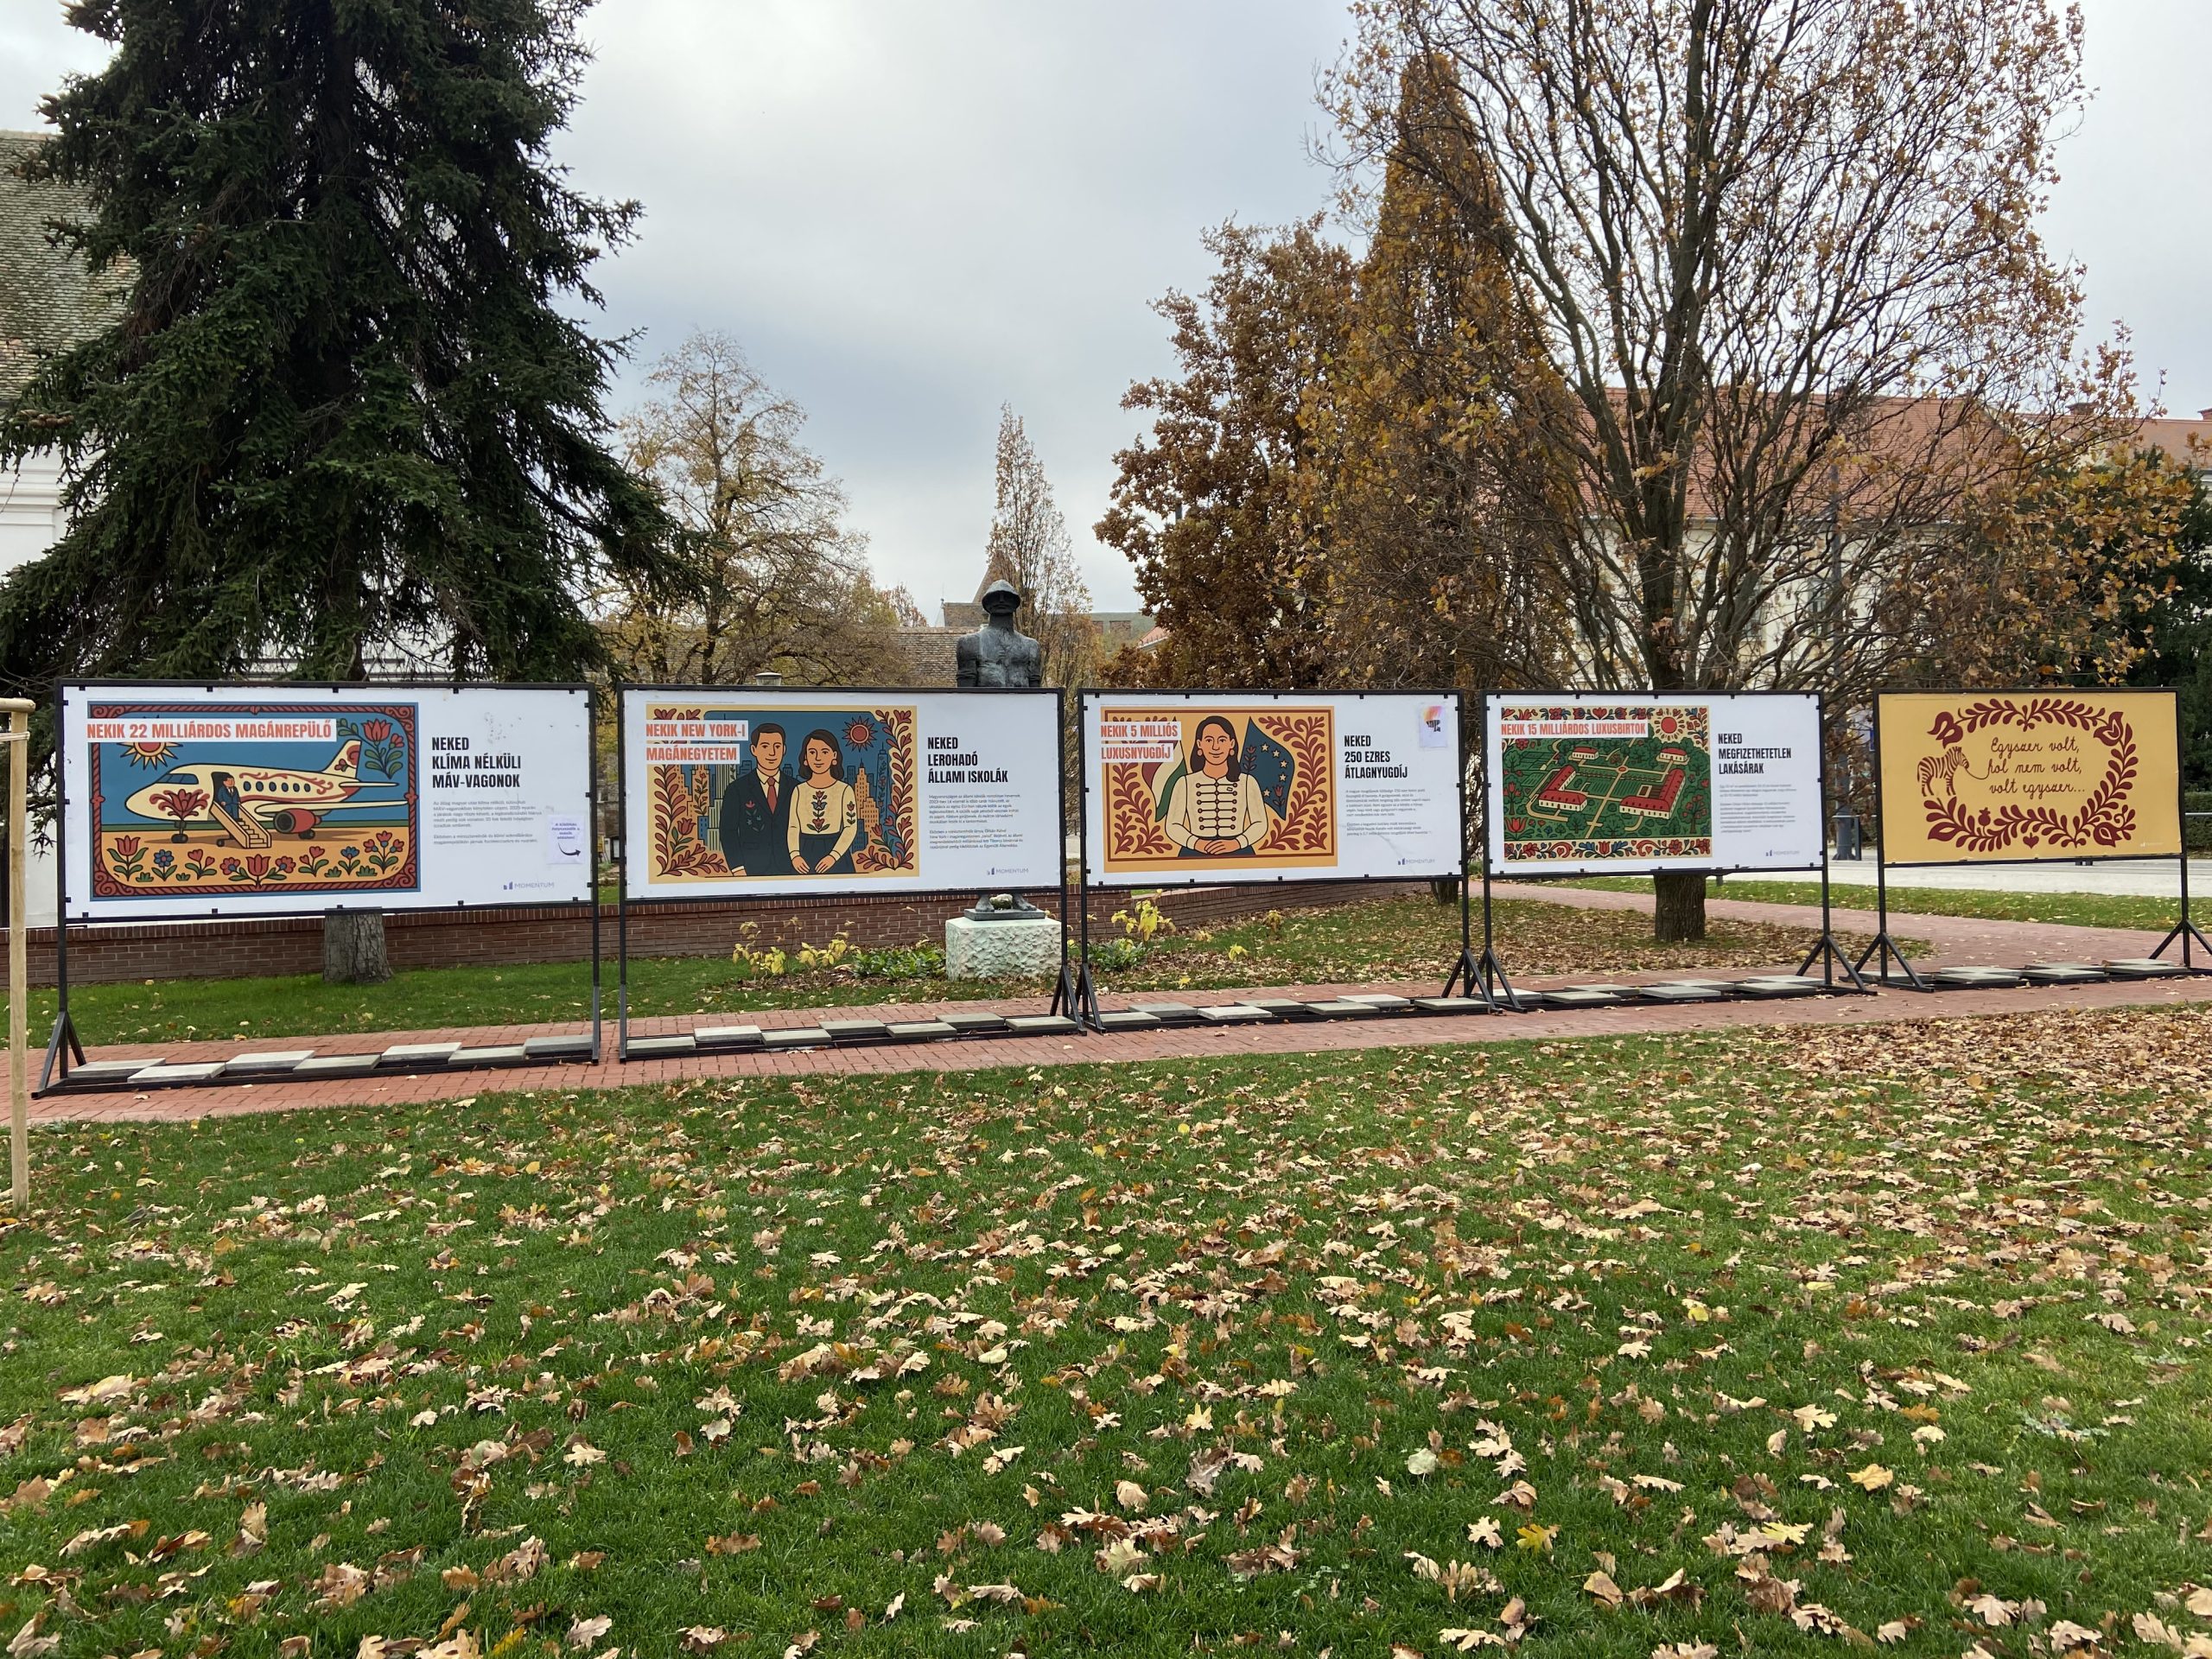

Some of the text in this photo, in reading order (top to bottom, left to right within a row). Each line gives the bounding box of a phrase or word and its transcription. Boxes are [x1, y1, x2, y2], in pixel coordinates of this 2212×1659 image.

[86, 719, 331, 739] NEKIK 22 MILLIÁRDOS MAGÁNREPÜLŐ
[645, 723, 746, 737] NEKIK NEW YORK-I
[1101, 721, 1178, 738] NEKIK 5 MILLIÓS
[1501, 721, 1646, 735] NEKIK 15 MILLIÁRDOS LUXUSBIRTOK
[431, 736, 470, 751] NEKED
[927, 736, 958, 750] NEKED
[1344, 734, 1372, 747] NEKED
[1718, 733, 1743, 745] NEKED
[646, 744, 737, 760] MAGÁNEGYETEM
[1102, 743, 1171, 760] LUXUSNYUGDÍJ
[1718, 747, 1792, 760] MEGFIZETHETETLEN
[1991, 735, 2080, 760] Egyszer volt,
[432, 753, 522, 770] KLÍMA NÉLKÜLI
[927, 750, 978, 766] LEROHADÓ
[1344, 750, 1391, 763] 250 EZRES
[1344, 764, 1408, 779] ÁTLAGNYUGDÍJ
[1719, 760, 1764, 775] LAKÁSÁRAK
[1988, 757, 2082, 775] hol nem volt,
[432, 771, 521, 789] MÁV-VAGONOK
[927, 767, 1009, 784] ÁLLAMI ISKOLÁK
[1989, 778, 2086, 800] volt egyszer...
